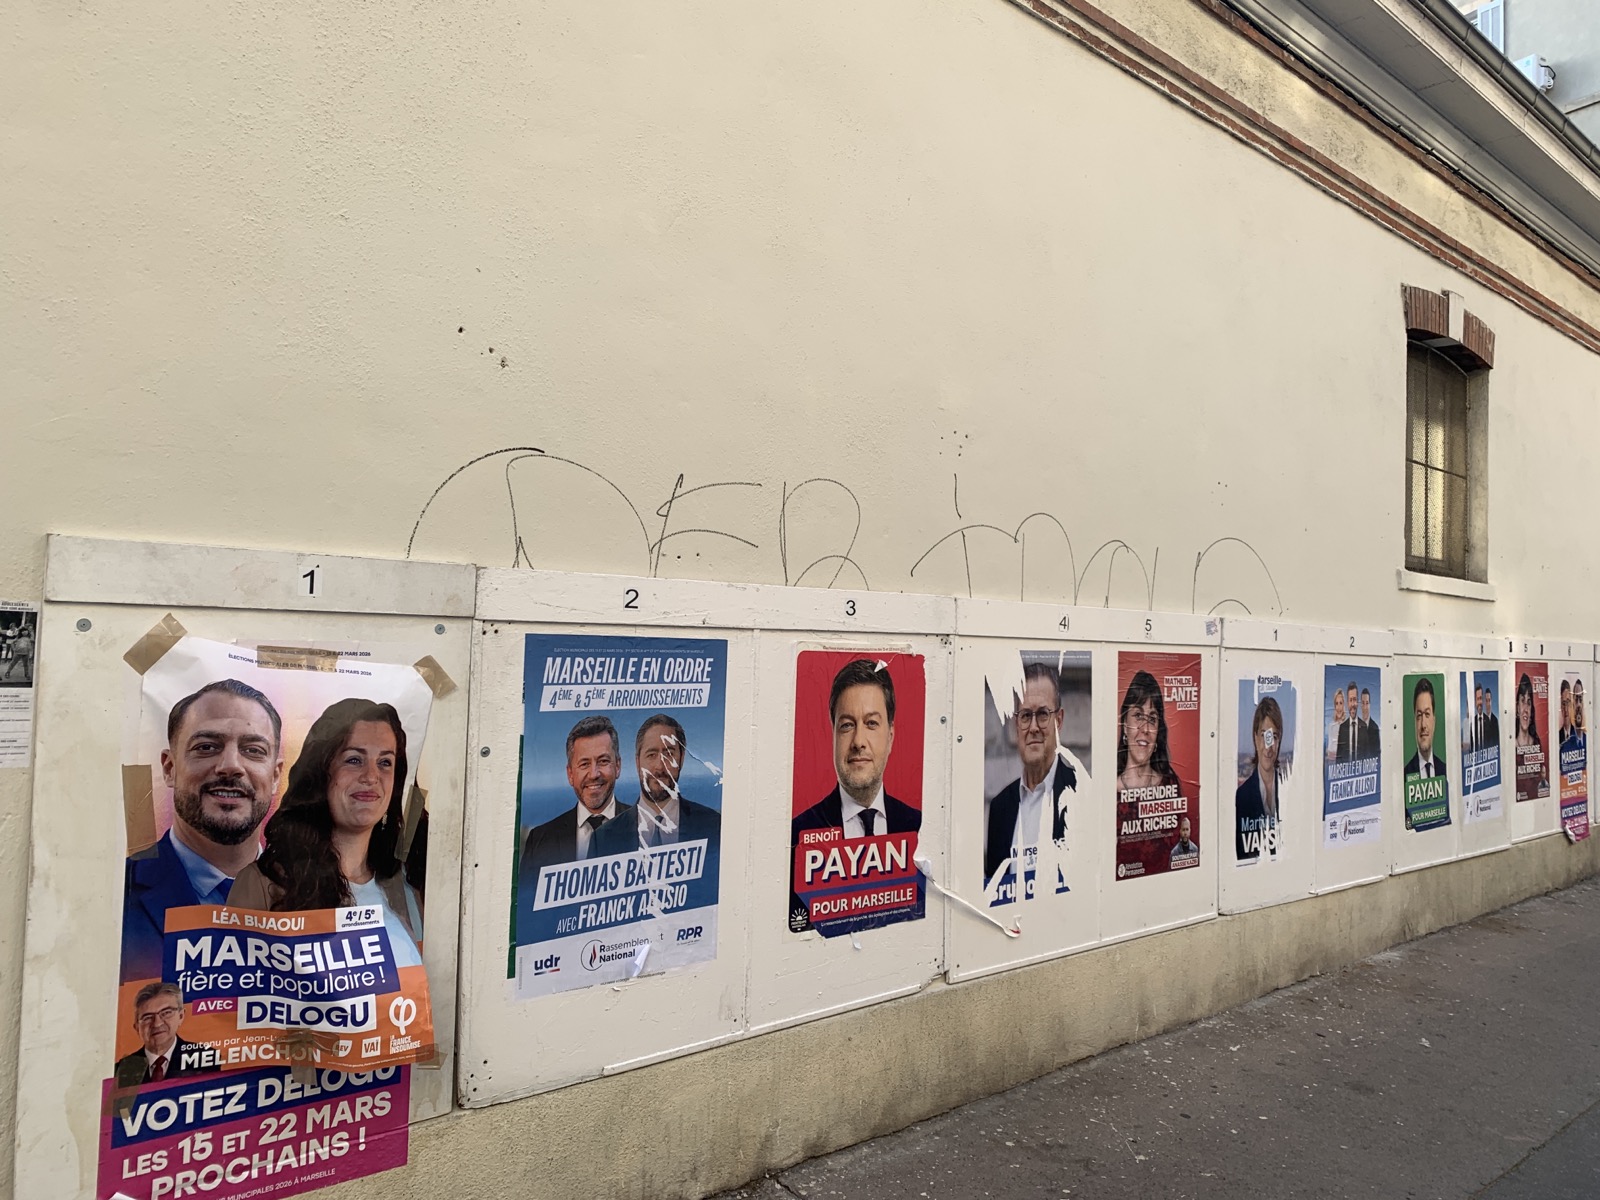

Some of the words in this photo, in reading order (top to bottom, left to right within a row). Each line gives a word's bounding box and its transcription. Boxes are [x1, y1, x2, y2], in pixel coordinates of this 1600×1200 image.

[303, 570, 315, 595] 1
[624, 588, 639, 609] 2
[845, 599, 857, 616] 3
[1059, 616, 1068, 630] 4
[1144, 619, 1152, 632] 5
[1272, 629, 1278, 641] 1
[1349, 636, 1356, 648] 2
[1423, 639, 1428, 649] 3
[1524, 643, 1529, 652] 5
[542, 656, 638, 684] MARSEILLE
[639, 657, 662, 683] EN
[663, 657, 714, 684] ORDRE
[1165, 677, 1192, 686] MATHILDE
[549, 688, 573, 709] 4ÈME
[574, 693, 581, 708] &
[583, 687, 607, 708] 5ÈME
[607, 688, 704, 707] ARRONDISSEMENTS
[1164, 682, 1199, 702] LANTÉ
[1561, 748, 1586, 765] MARSEILLE
[1328, 760, 1356, 781] MARSEILLE
[1355, 760, 1363, 776] EN
[1363, 757, 1379, 774] ORDRE
[1120, 784, 1178, 803] REPRENDRE
[1331, 780, 1355, 801] FRANCK
[1354, 776, 1375, 797] ALLISIO
[1408, 779, 1443, 804] PAYAN
[1140, 799, 1187, 816] MARSEILLE
[1412, 812, 1425, 822] POUR
[1424, 806, 1446, 819] MARSEILLE
[1120, 819, 1142, 836] AUX
[1143, 814, 1179, 832] RICHES
[1348, 826, 1365, 835] National
[803, 829, 841, 844] BENOÎT
[805, 839, 908, 884] PAYAN
[544, 860, 621, 903] THOMAS
[812, 901, 849, 916] POUR
[851, 888, 914, 910] MARSEILLE
[212, 907, 241, 925] LÉA
[244, 914, 305, 932] BIJAOUI
[341, 918, 380, 928] arrondissements
[556, 917, 577, 934] AVEC
[577, 895, 636, 930] FRANCK
[676, 926, 703, 942] RPR
[175, 934, 385, 974] MARSEILLE
[534, 954, 561, 971] udr
[599, 949, 636, 964] National
[177, 969, 233, 993] fière
[239, 969, 265, 989] et
[270, 969, 375, 999] populaire
[379, 965, 387, 984] !
[196, 999, 233, 1013] AVEC
[245, 1001, 369, 1028] DELOGU
[181, 1039, 222, 1051] soutenu
[223, 1038, 241, 1048] par
[390, 1036, 412, 1047] FRANCE
[390, 1040, 421, 1054] INSOUMISE
[181, 1042, 321, 1071] MÉLENCHON
[119, 1082, 248, 1138] VOTEZ
[122, 1149, 169, 1180] LES
[177, 1131, 213, 1165] 15
[222, 1129, 251, 1155] ET
[258, 1113, 298, 1146] 22
[305, 1090, 392, 1134] MARS
[151, 1130, 350, 1200] PROCHAINS
[358, 1126, 368, 1152] !
[274, 1179, 293, 1191] 2026
[293, 1177, 300, 1185] À
[300, 1168, 336, 1183] MARSEILLE
